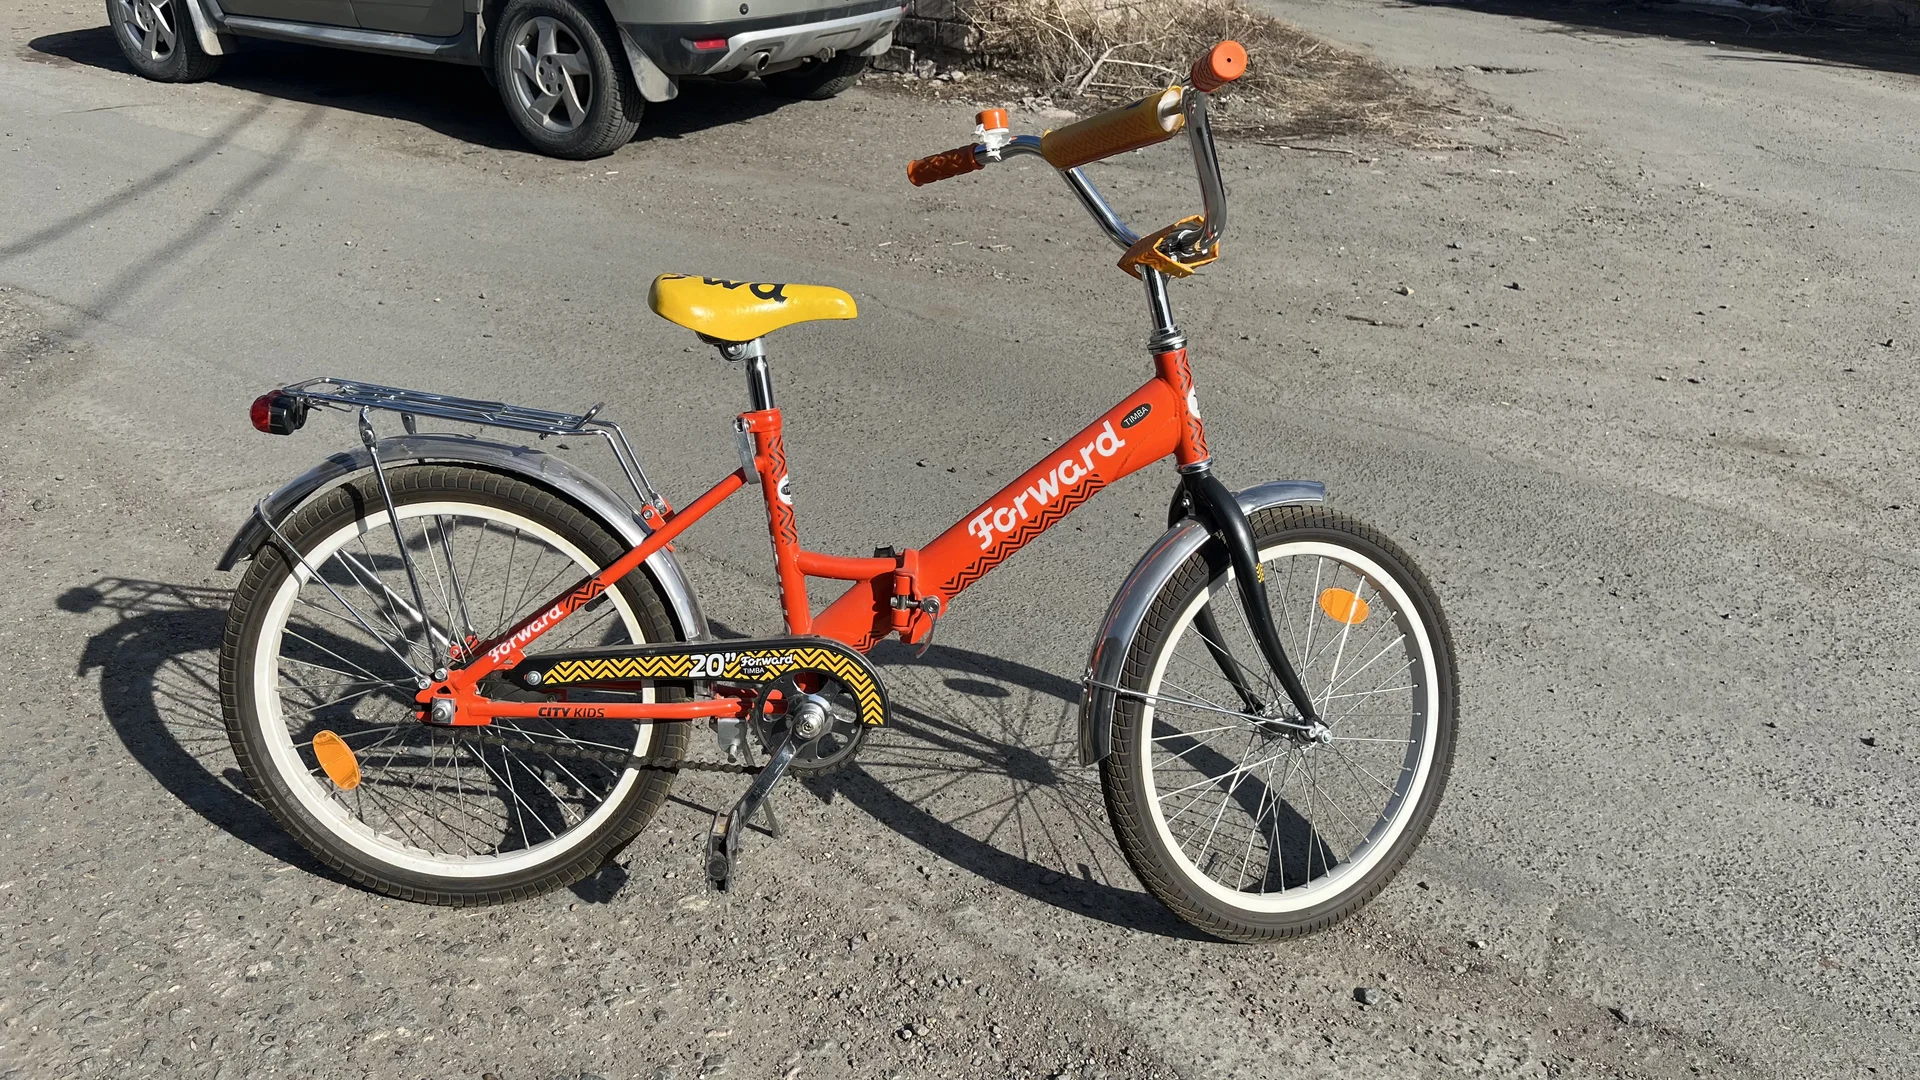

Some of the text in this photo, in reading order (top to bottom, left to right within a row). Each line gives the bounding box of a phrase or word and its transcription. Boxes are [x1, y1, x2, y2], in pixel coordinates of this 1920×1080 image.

[1123, 405, 1149, 427] TIMBA
[967, 419, 1126, 550] Forward
[740, 653, 794, 667] Forward
[743, 667, 765, 675] TIMBA
[538, 706, 605, 718] CITY KIDS
